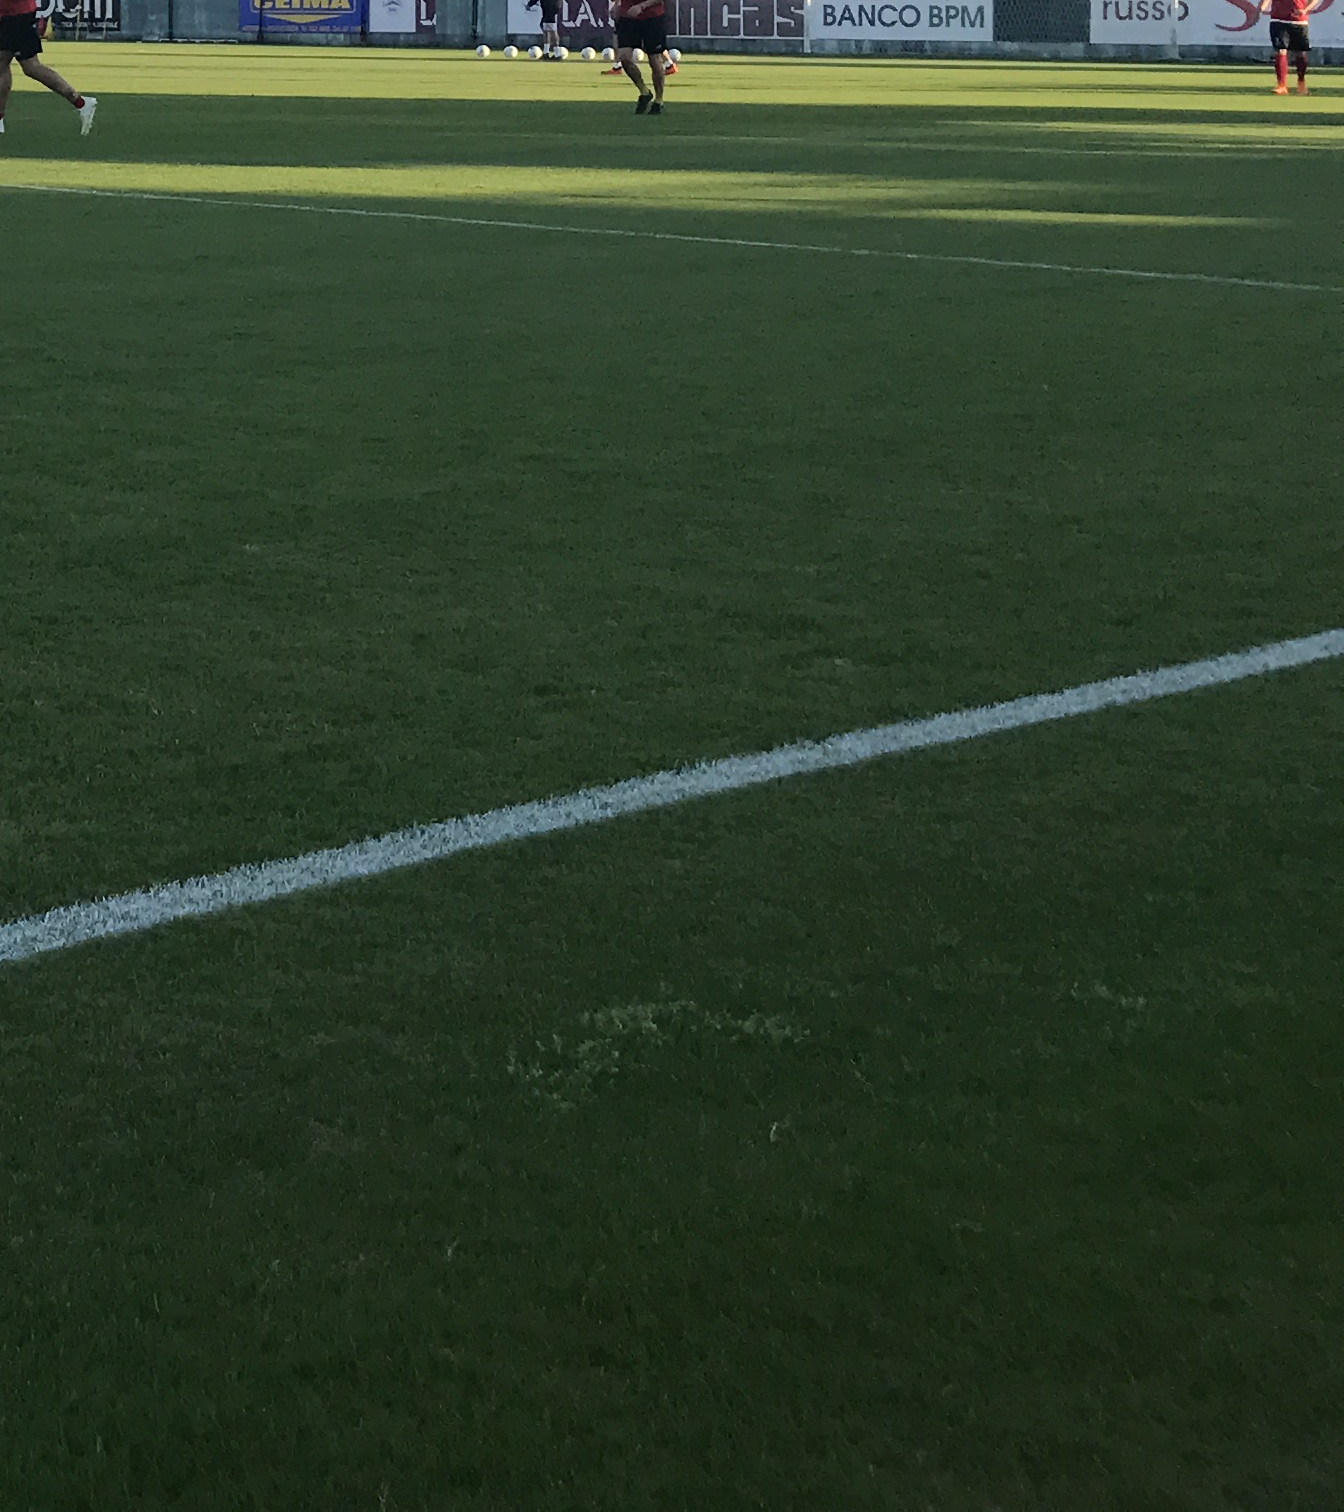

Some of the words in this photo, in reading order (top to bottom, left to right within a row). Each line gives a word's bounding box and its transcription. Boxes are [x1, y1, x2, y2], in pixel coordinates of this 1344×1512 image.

[822, 4, 921, 28] BANCO
[928, 5, 985, 28] BPM
[1102, 0, 1189, 21] russo
